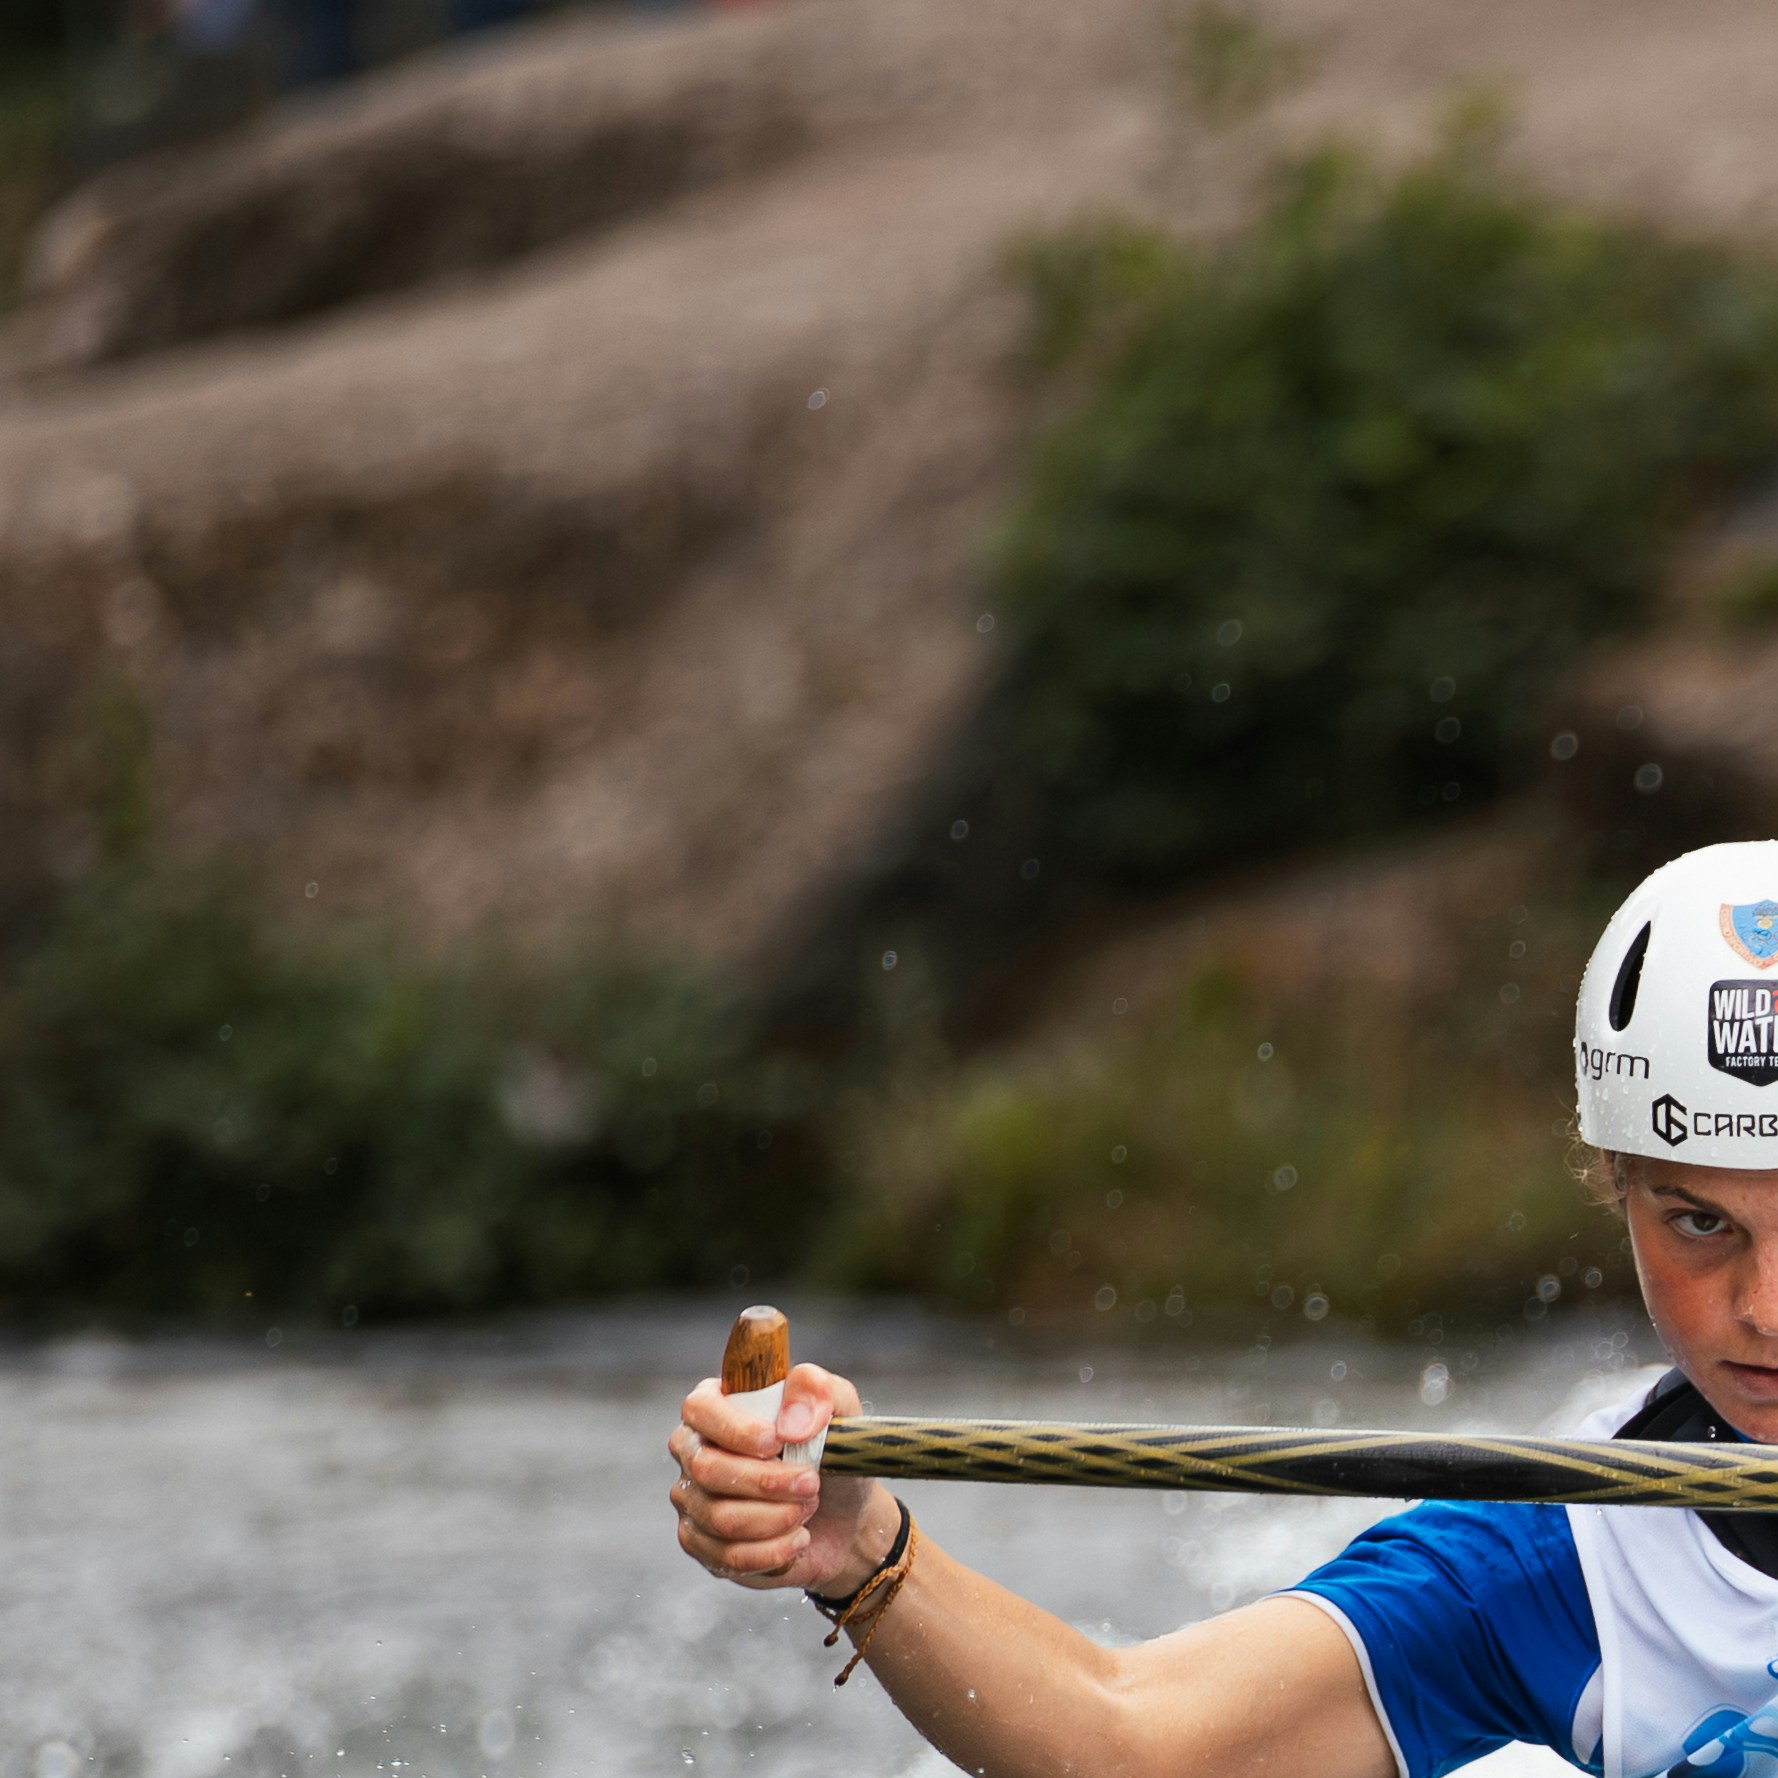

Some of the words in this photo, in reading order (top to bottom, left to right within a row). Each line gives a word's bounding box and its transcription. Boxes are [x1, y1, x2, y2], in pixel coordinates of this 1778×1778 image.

[1713, 988, 1771, 1020] WILD
[1591, 1049, 1650, 1080] grm
[1725, 1056, 1766, 1067] FACTORY
